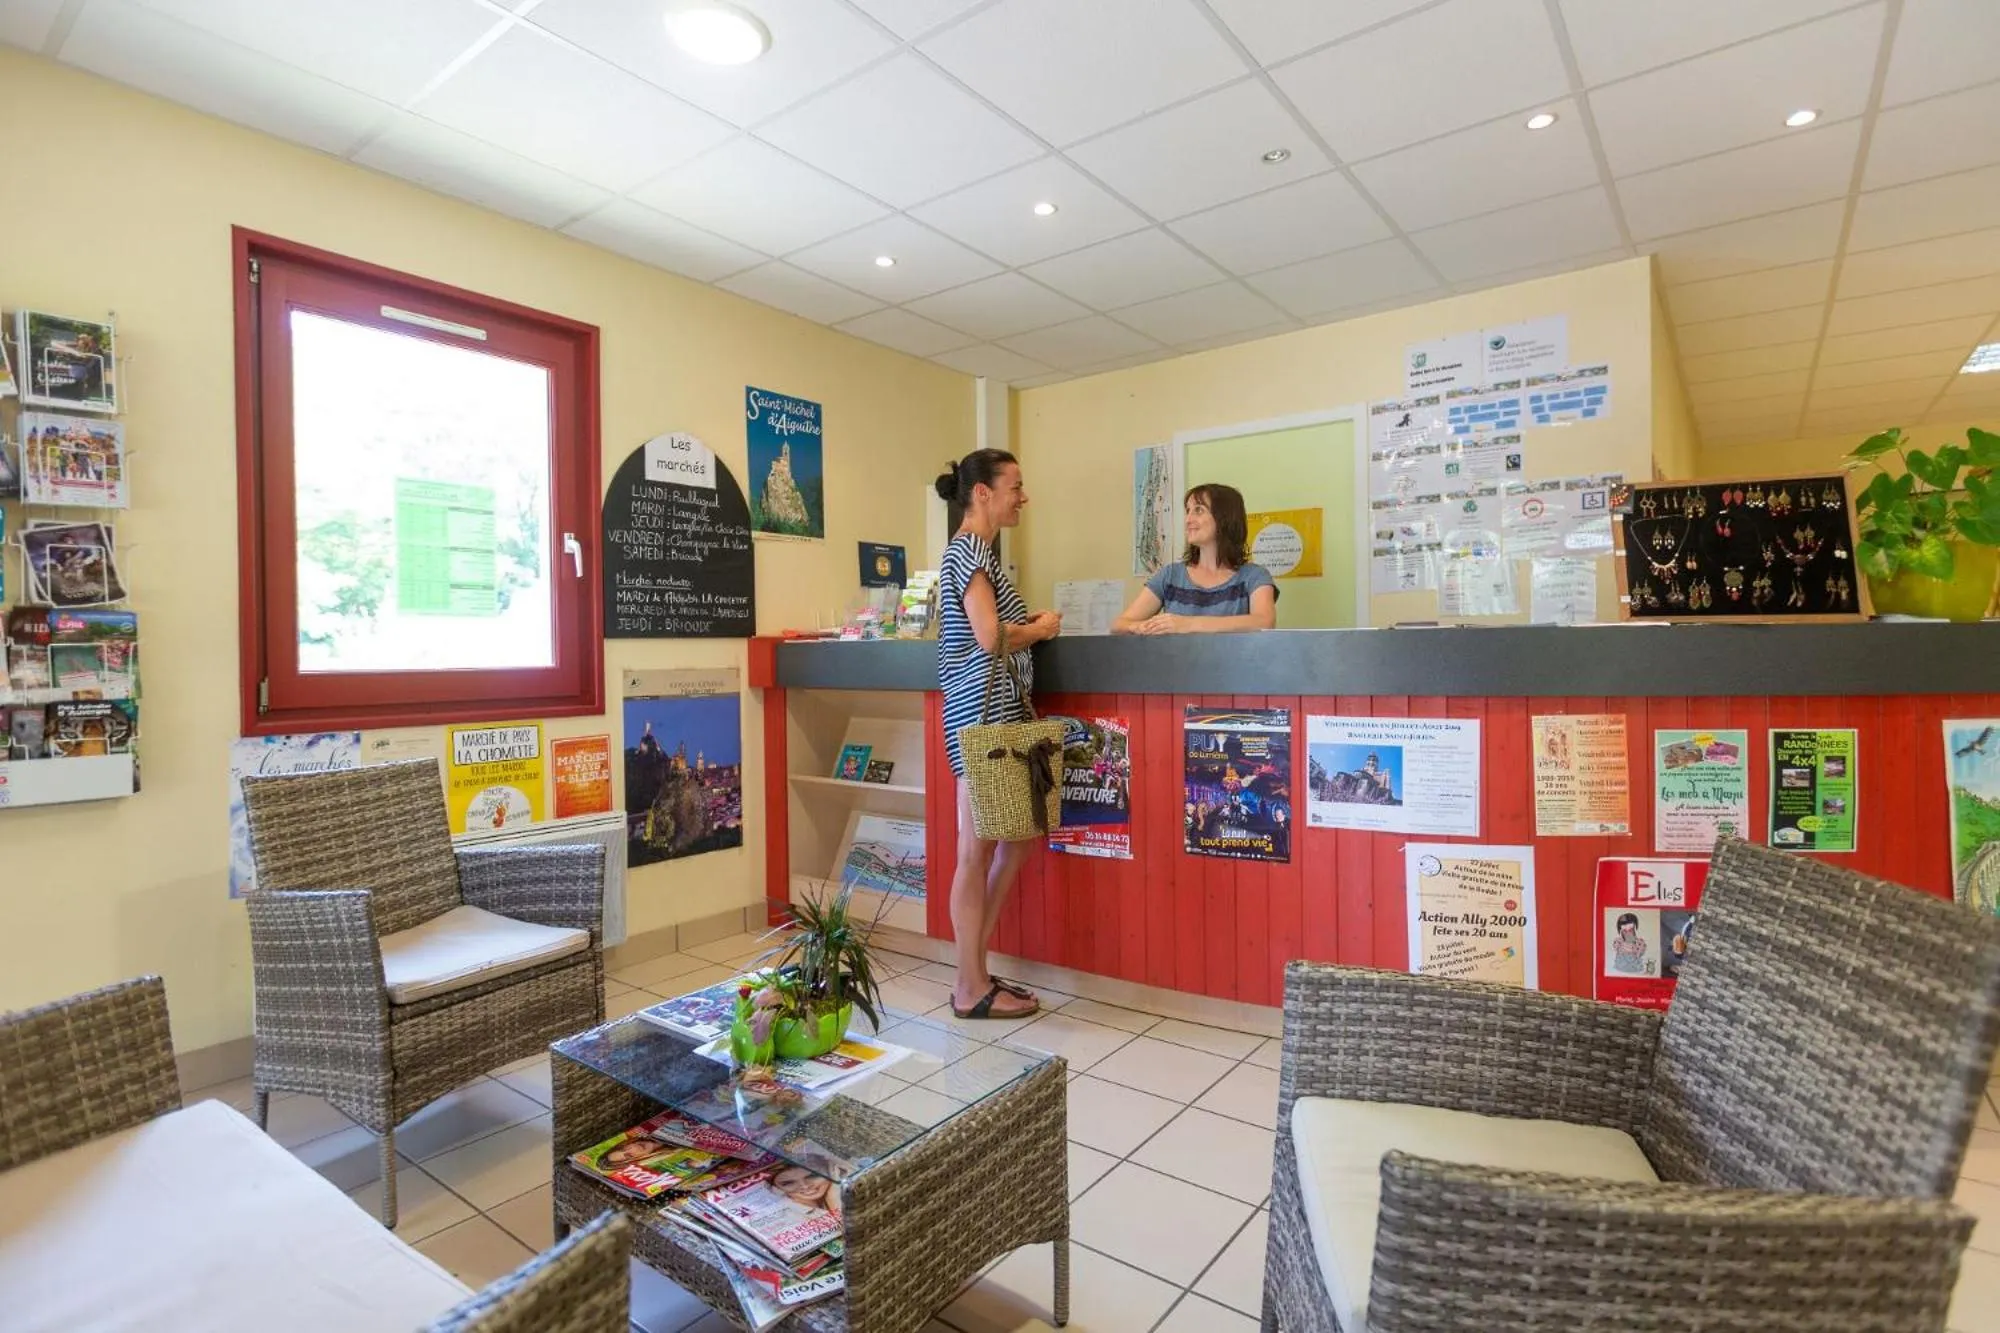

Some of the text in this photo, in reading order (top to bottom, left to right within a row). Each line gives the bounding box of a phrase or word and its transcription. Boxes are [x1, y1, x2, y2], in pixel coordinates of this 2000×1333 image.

[671, 437, 691, 451] Les
[657, 459, 705, 473] marchés
[458, 745, 534, 763] LA CHOMETTE
[1791, 754, 1817, 767] 4x4
[1063, 768, 1095, 783] PARC
[1060, 786, 1118, 804] AVENTURE
[1201, 837, 1268, 848] tout prend vie
[1418, 911, 1527, 928] Action Ally 2000
[1455, 929, 1470, 937] ses
[1472, 928, 1487, 937] 20
[1489, 931, 1508, 939] ans
